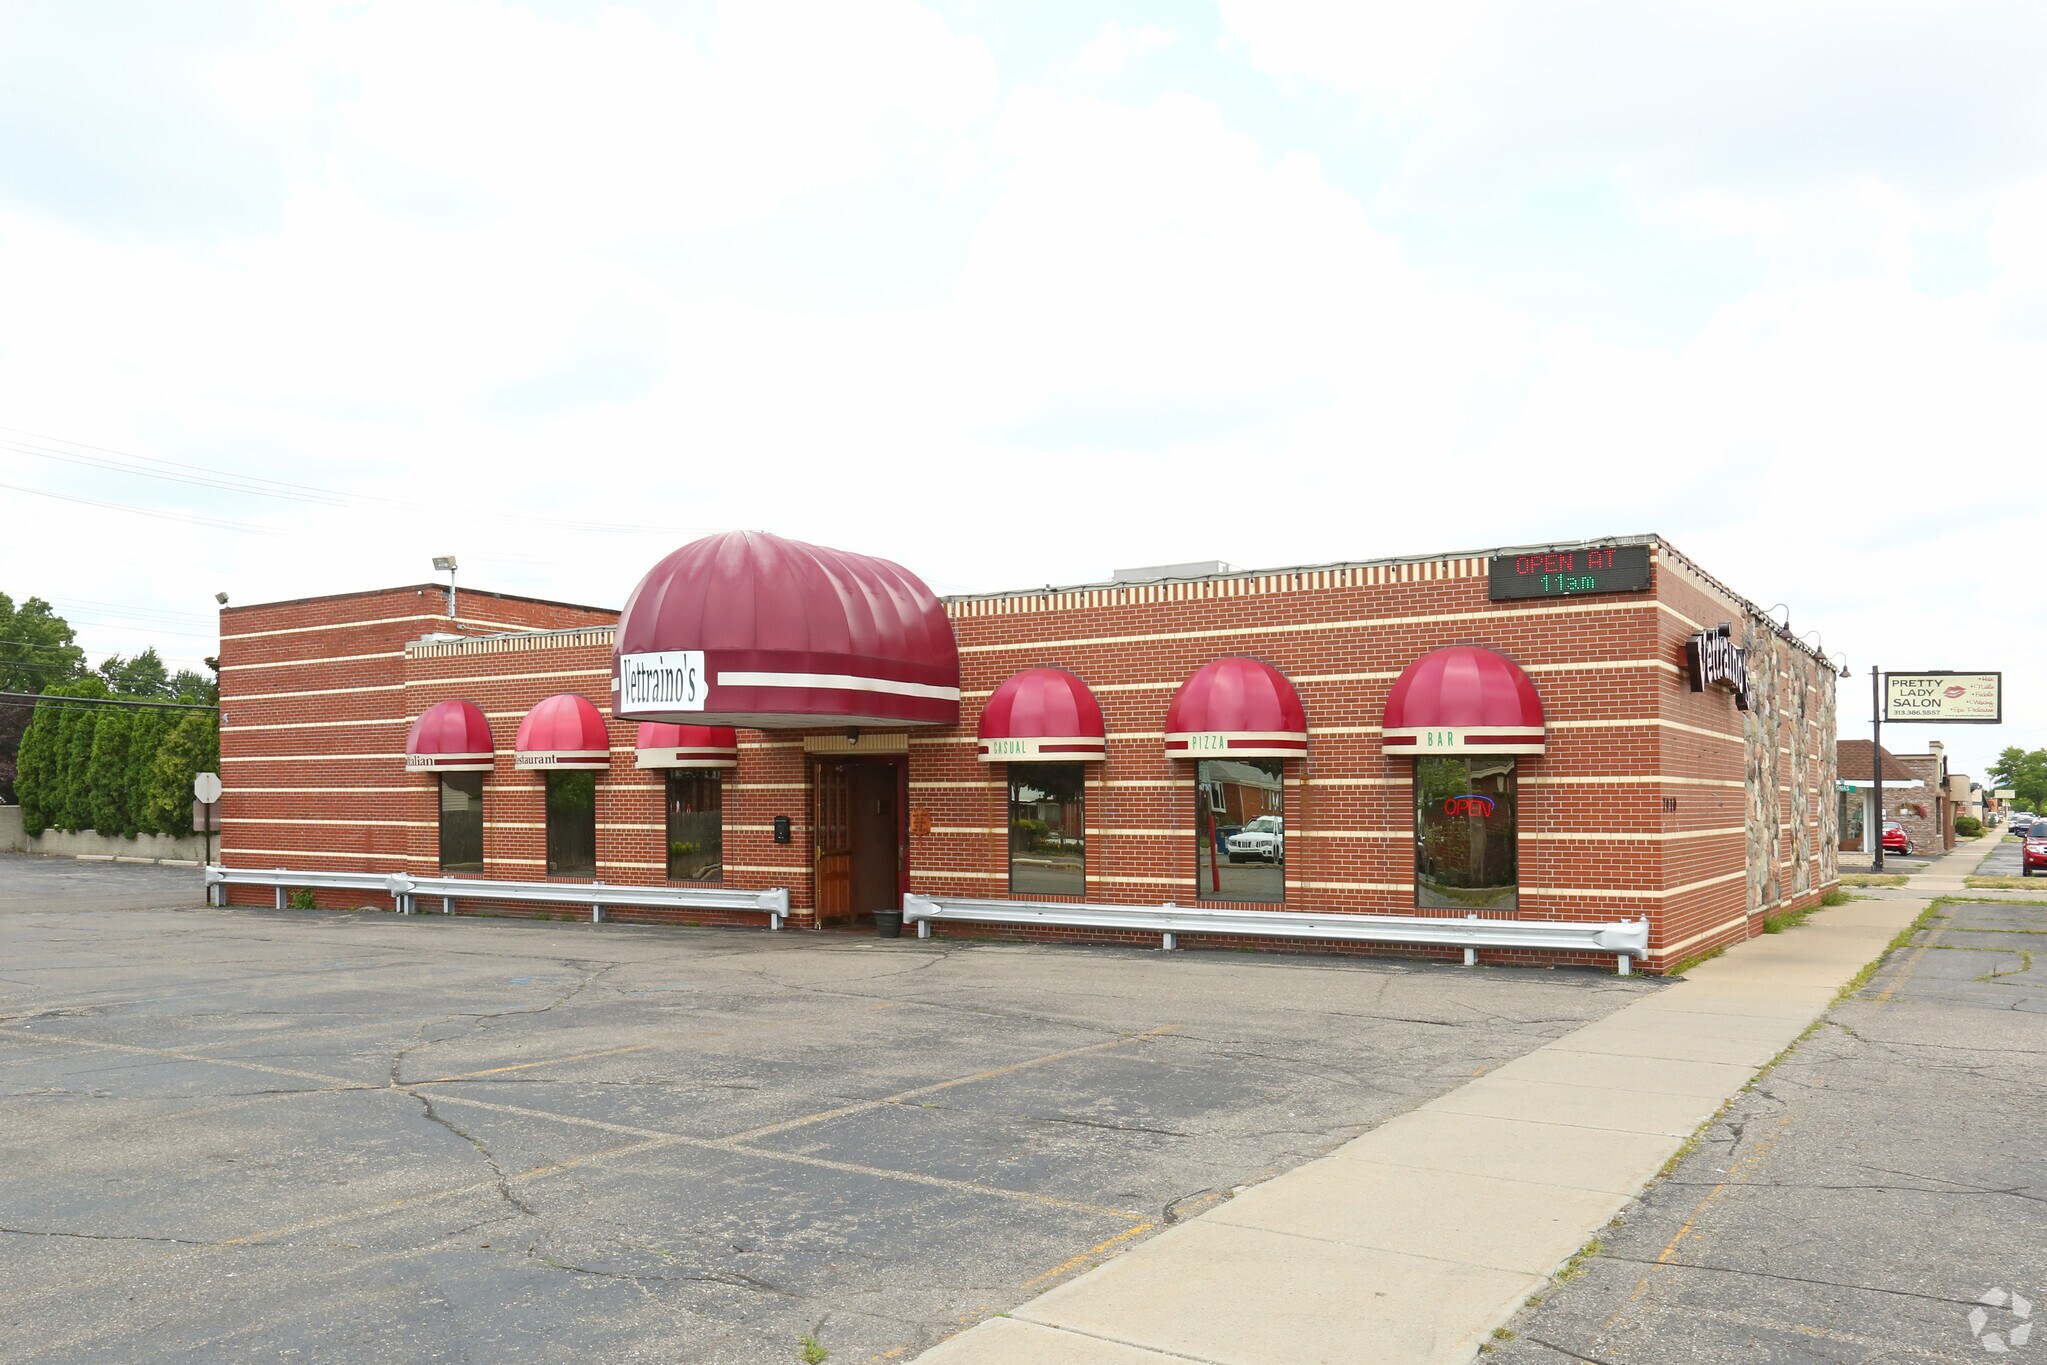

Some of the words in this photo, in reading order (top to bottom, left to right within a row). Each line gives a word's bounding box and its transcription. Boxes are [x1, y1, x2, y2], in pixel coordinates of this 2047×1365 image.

[1516, 553, 1574, 575] OPEN
[1588, 549, 1617, 570] AT
[1540, 573, 1596, 592] 11am
[623, 653, 696, 704] Vettraino's
[1893, 699, 1942, 707] SALON
[993, 740, 1027, 754] CASUAL
[1192, 735, 1225, 750] PIZZA
[1427, 731, 1454, 747] BAR
[515, 754, 557, 765] estaurant
[1444, 798, 1492, 817] OPEN
